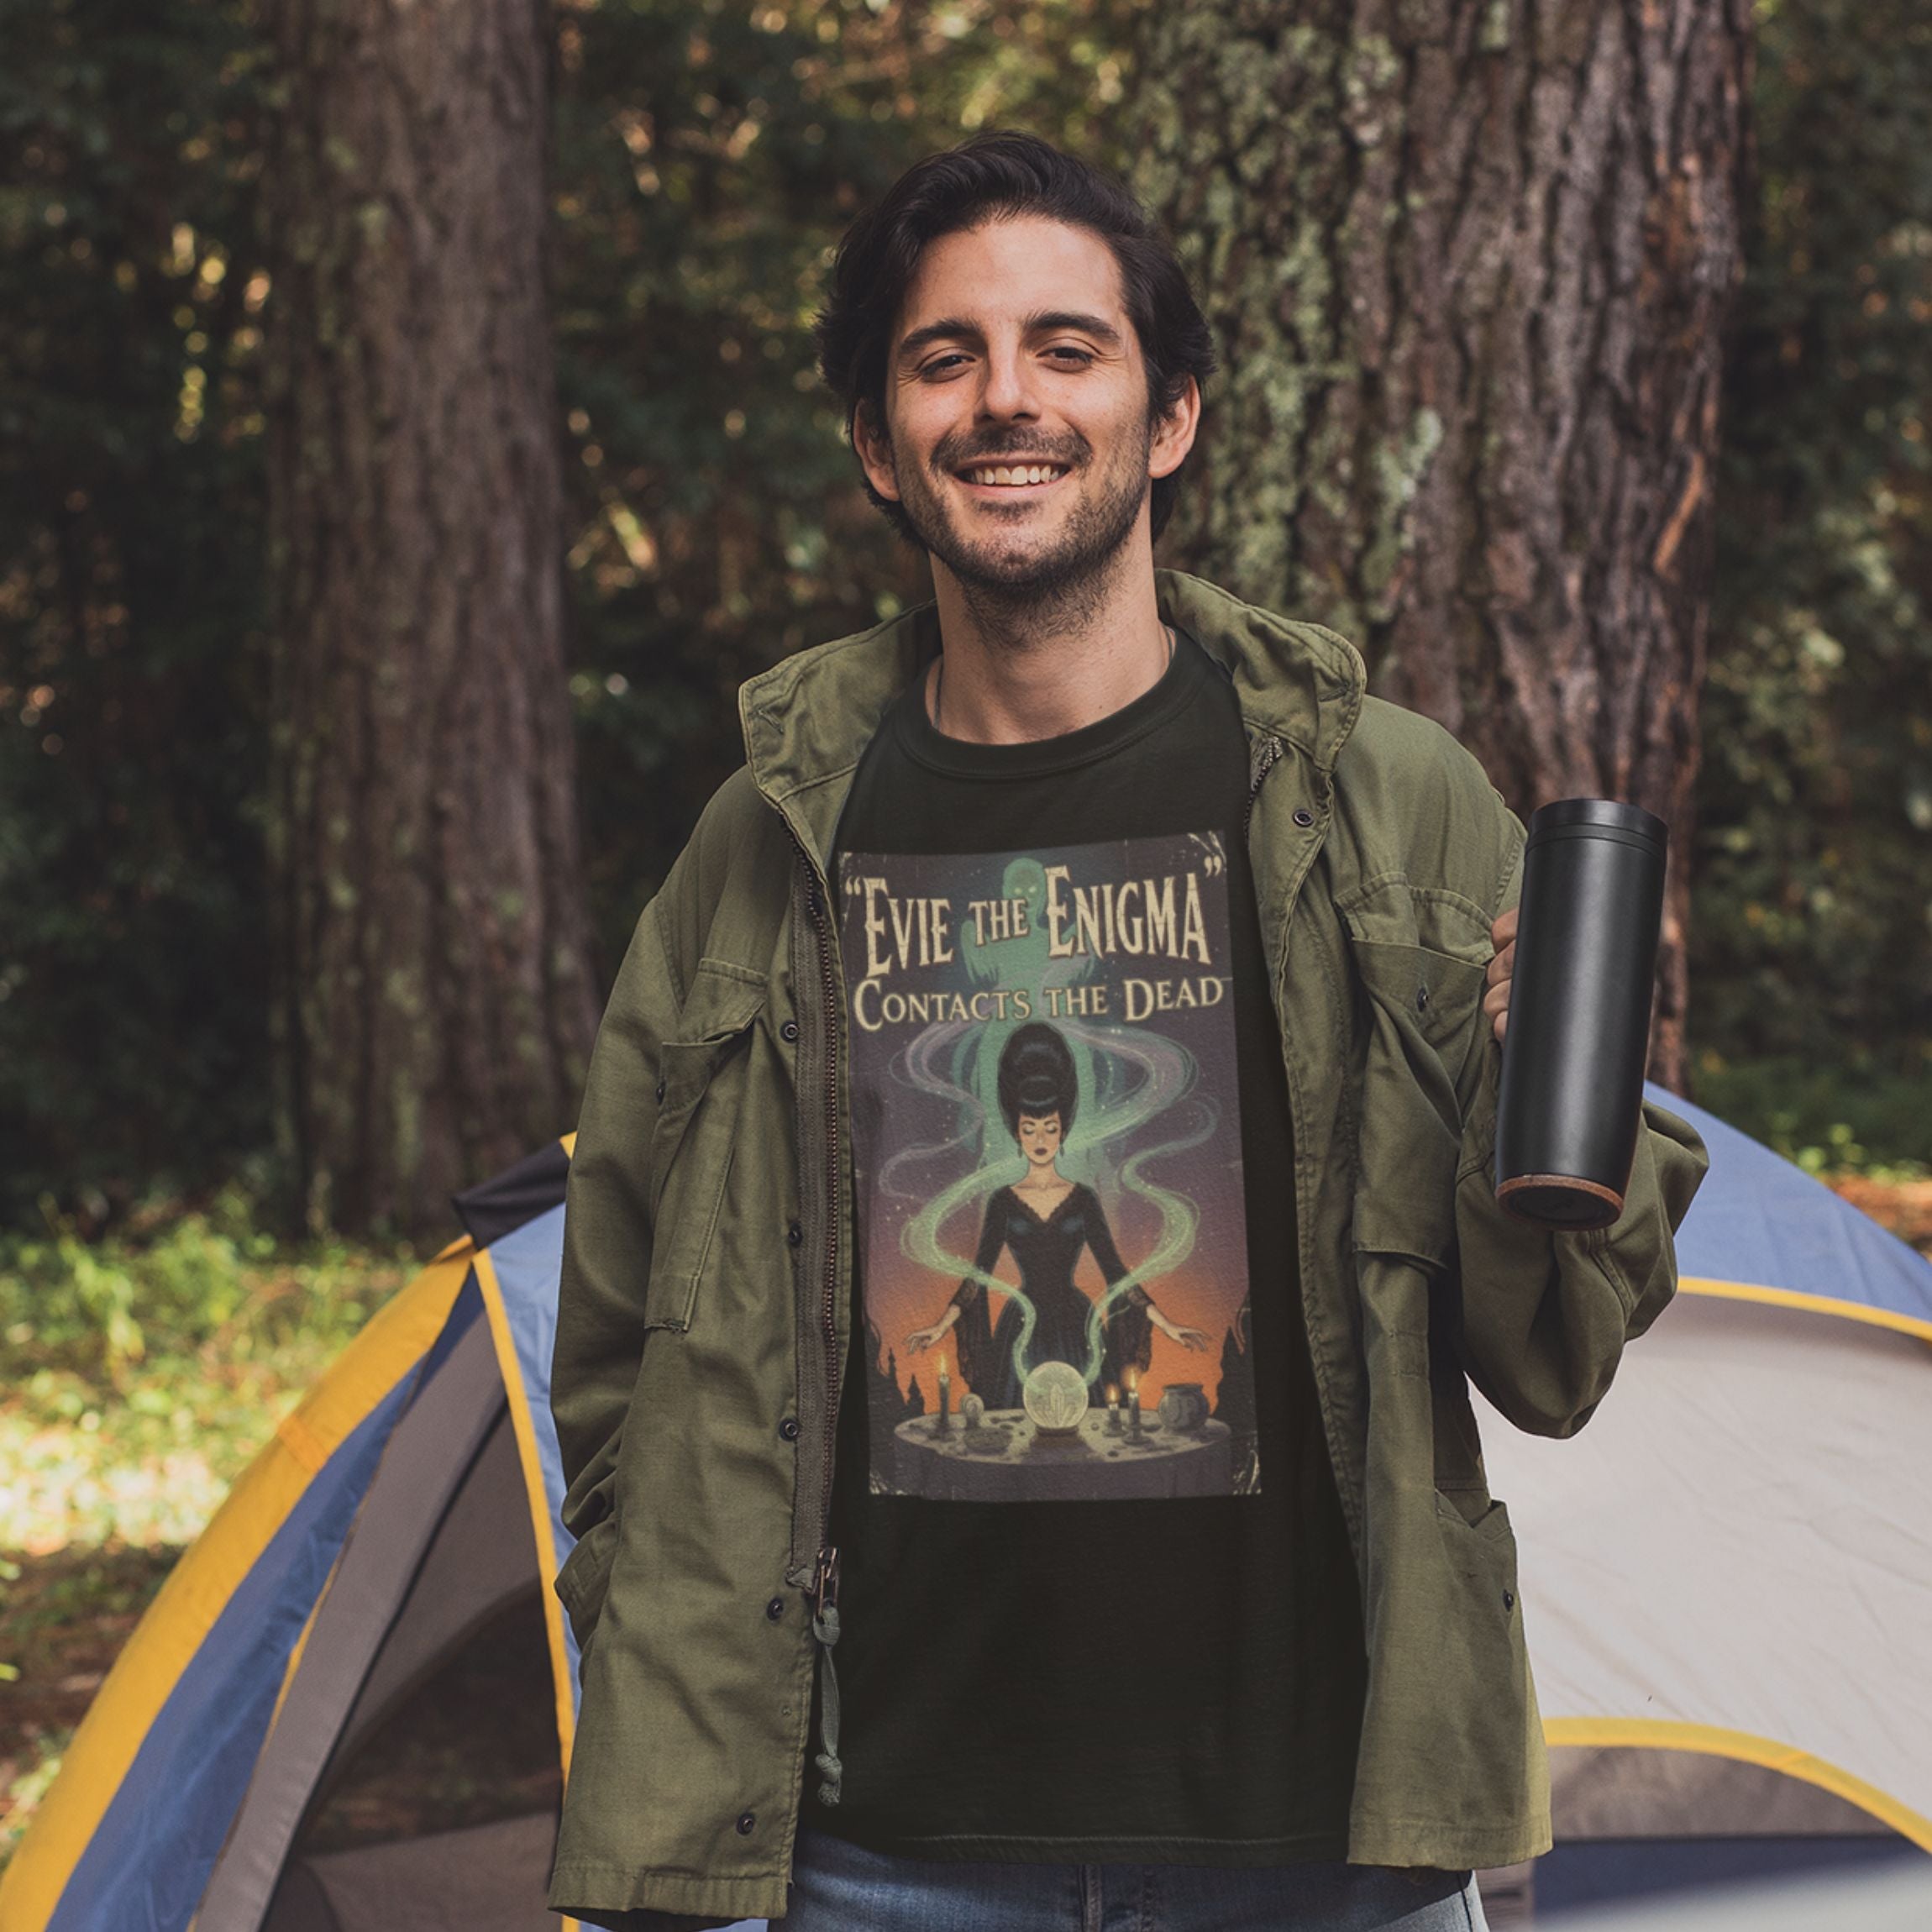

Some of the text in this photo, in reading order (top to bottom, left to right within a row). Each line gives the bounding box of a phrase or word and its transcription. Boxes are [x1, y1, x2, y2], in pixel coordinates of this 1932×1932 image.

[969, 898, 1030, 947] THE
[854, 976, 1225, 1032] CONTACTS THE DEAD
